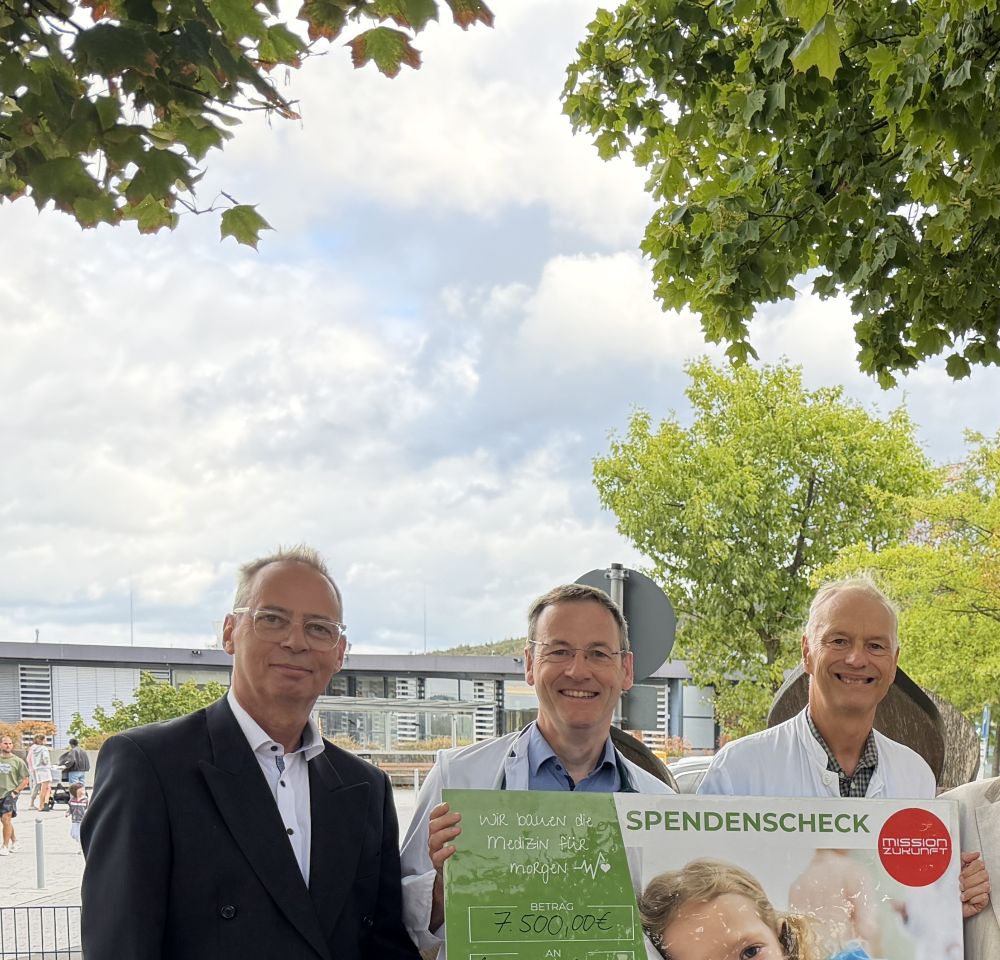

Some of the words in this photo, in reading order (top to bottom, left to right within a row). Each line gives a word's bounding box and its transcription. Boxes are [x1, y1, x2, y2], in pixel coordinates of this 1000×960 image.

[517, 813, 566, 827] bauen
[576, 814, 594, 826] die
[626, 810, 871, 833] SPENDENSCHECK
[487, 836, 549, 850] Medizin
[559, 836, 589, 851] für
[882, 838, 948, 847] MISSION
[882, 847, 948, 855] ZUKUNFT
[510, 862, 567, 884] morgen
[530, 903, 574, 911] BETRAG
